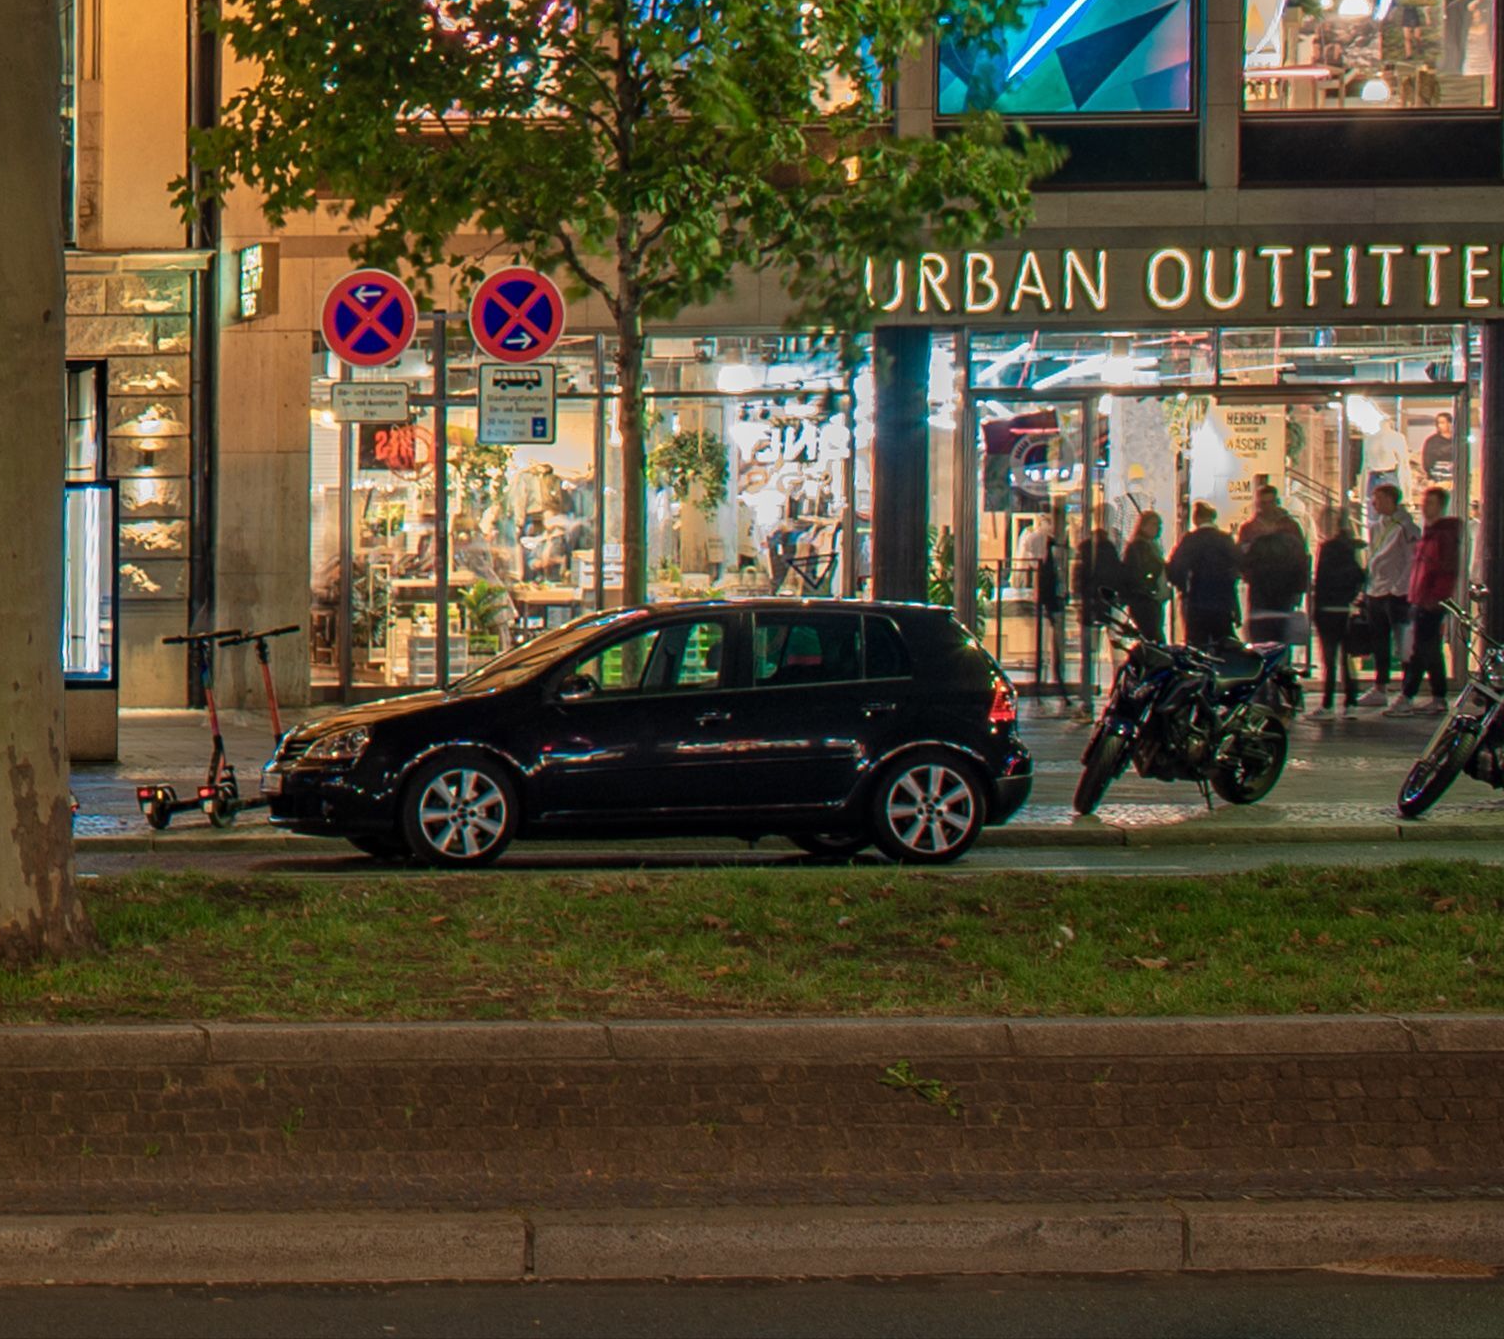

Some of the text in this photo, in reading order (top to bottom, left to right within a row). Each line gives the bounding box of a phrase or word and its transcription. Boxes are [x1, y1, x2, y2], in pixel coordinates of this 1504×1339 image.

[865, 245, 1504, 313] URBAN OUTFITTE
[1226, 412, 1267, 426] HERREN
[1229, 480, 1252, 493] DAM
